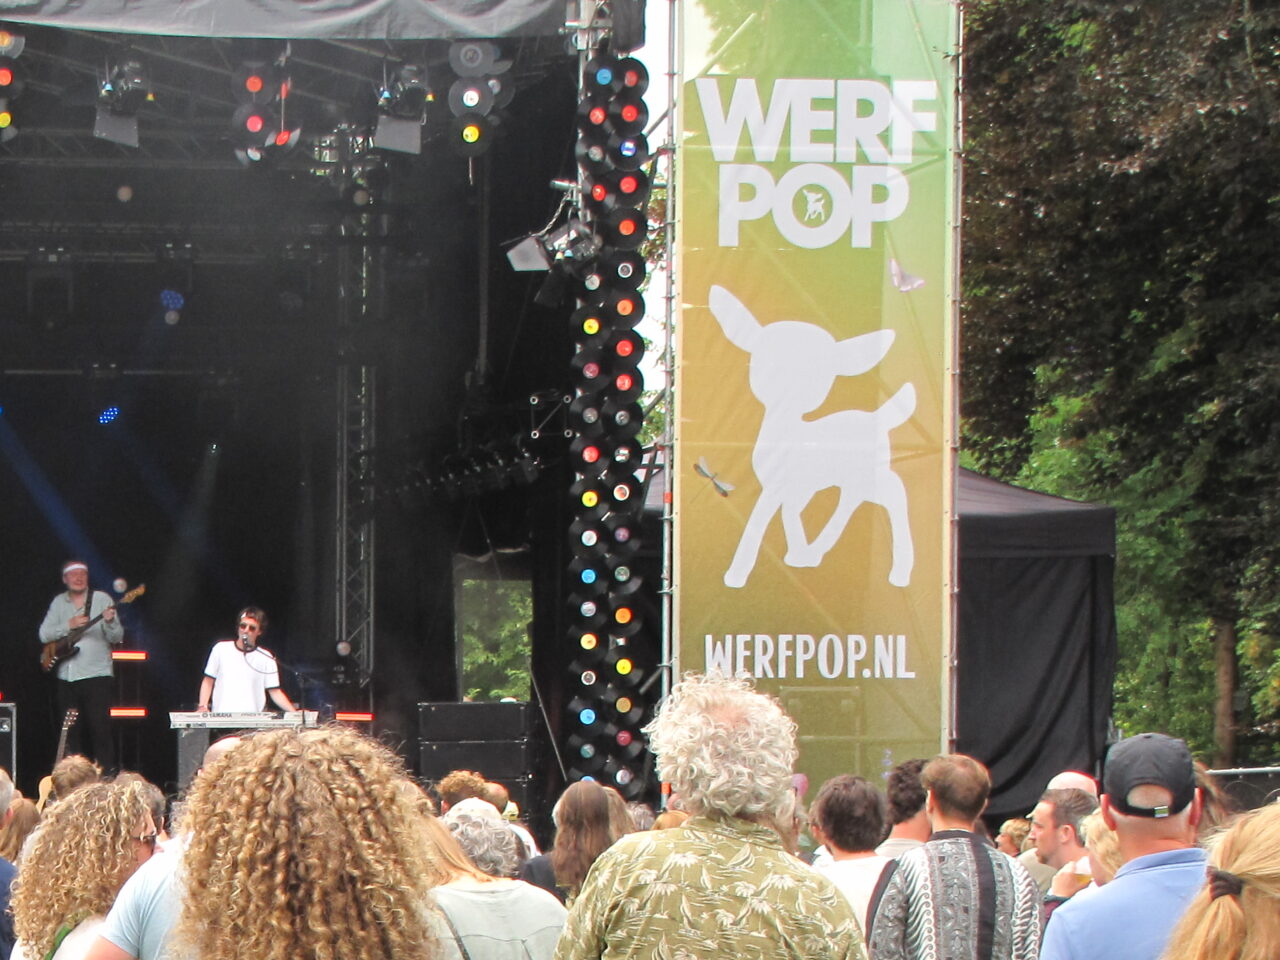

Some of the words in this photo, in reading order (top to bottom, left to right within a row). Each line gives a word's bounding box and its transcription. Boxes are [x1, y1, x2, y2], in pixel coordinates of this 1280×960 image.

[695, 77, 936, 164] WERF
[718, 163, 909, 249] POP
[705, 634, 916, 679] WERFPOP.NL
